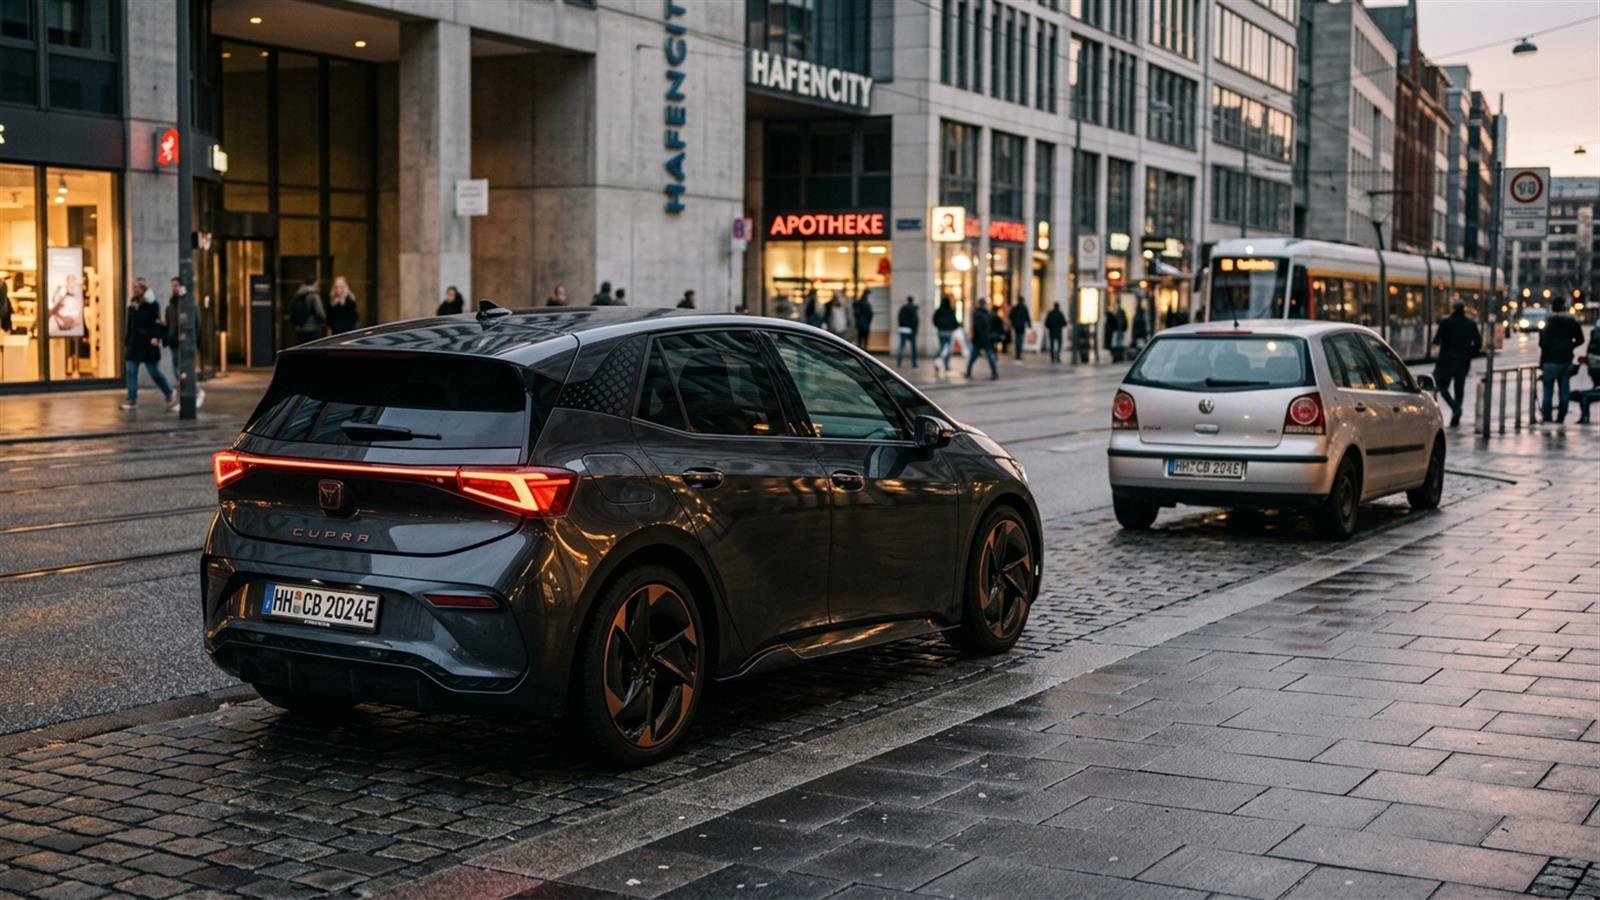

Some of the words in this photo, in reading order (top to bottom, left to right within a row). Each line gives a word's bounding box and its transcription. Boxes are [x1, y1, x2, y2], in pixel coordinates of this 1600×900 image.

[752, 48, 873, 107] HAFENCITY
[770, 213, 884, 236] APOTHEKE
[292, 527, 370, 543] CUPRA
[273, 588, 295, 613] HH
[302, 592, 323, 616] CB
[324, 595, 376, 624] 2024E
